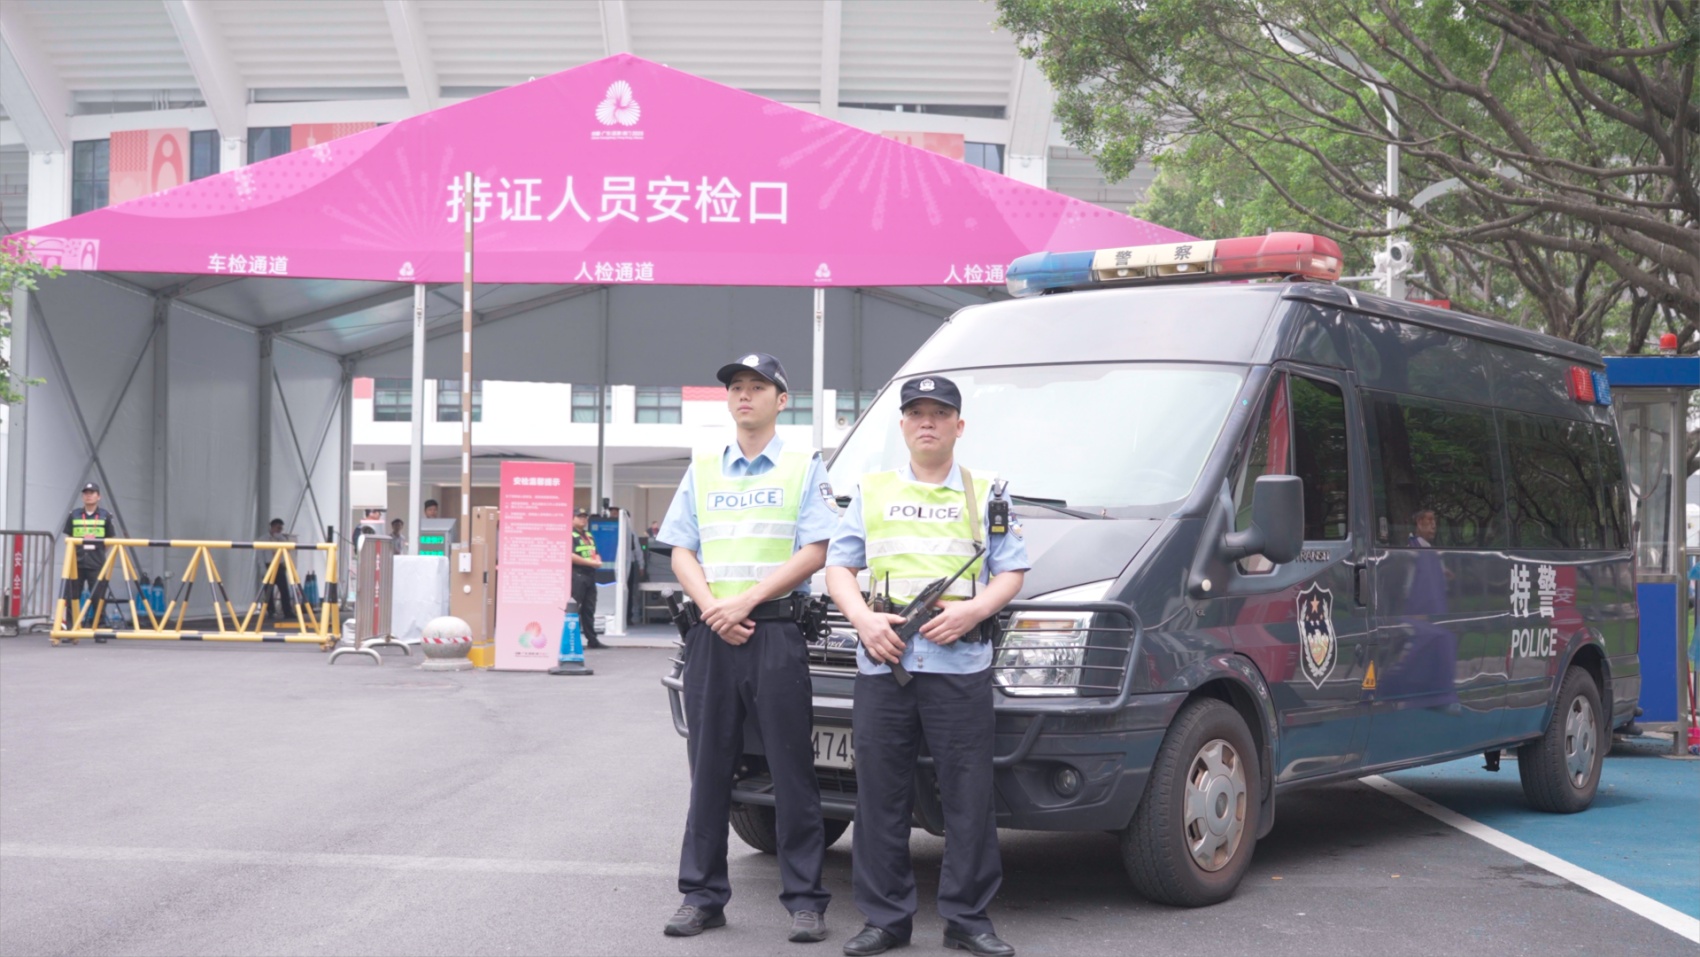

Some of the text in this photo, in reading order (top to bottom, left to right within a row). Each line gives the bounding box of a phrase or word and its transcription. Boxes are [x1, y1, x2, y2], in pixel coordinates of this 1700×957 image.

[446, 175, 788, 224] 持证人员安检口
[207, 253, 288, 275] 车检通道
[1115, 245, 1192, 266] 警察
[574, 261, 655, 281] 人检通道
[943, 264, 1010, 284] 人检通
[714, 491, 777, 507] POLICE
[890, 505, 959, 519] POLICE
[1510, 564, 1556, 618] 特警
[1510, 628, 1558, 658] POLICE
